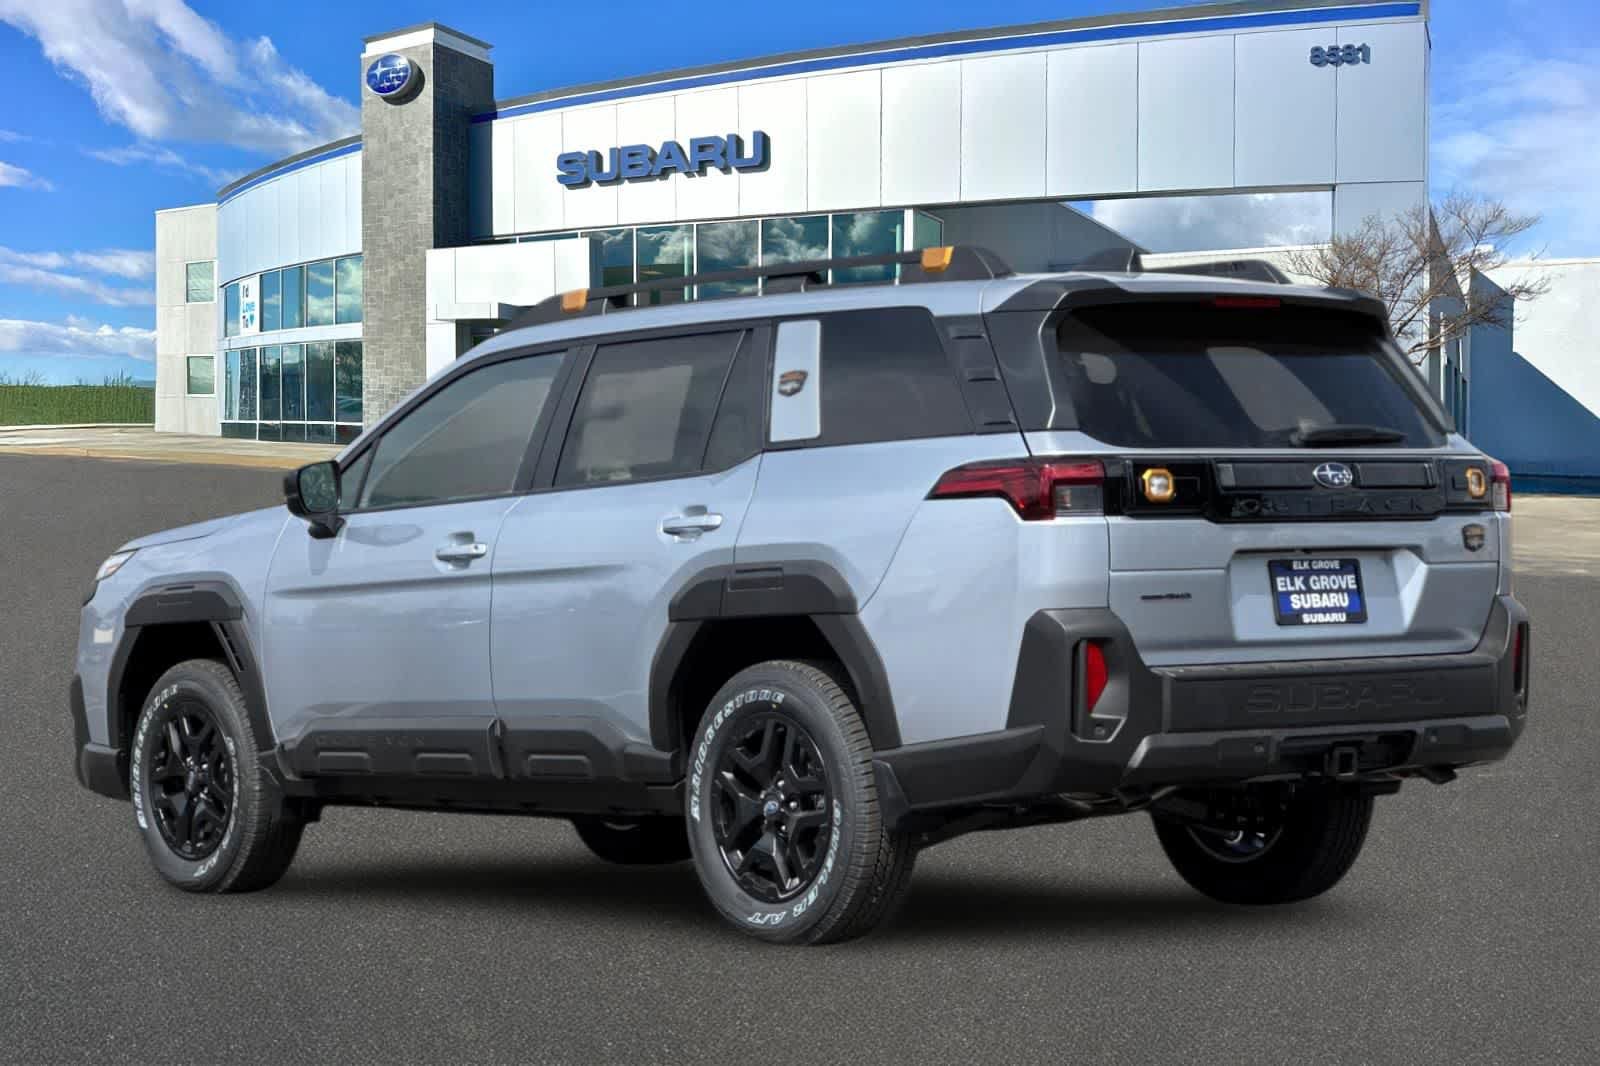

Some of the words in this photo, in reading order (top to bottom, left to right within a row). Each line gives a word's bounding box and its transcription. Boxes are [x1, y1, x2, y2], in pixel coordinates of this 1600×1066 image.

[556, 130, 769, 189] SUBARU
[1293, 560, 1310, 570] ELK
[1312, 560, 1340, 569] GROVE
[1276, 576, 1306, 592] ELK
[1309, 574, 1357, 591] GROVE
[1290, 593, 1349, 609] SUBARU
[1302, 612, 1347, 623] SUBARU
